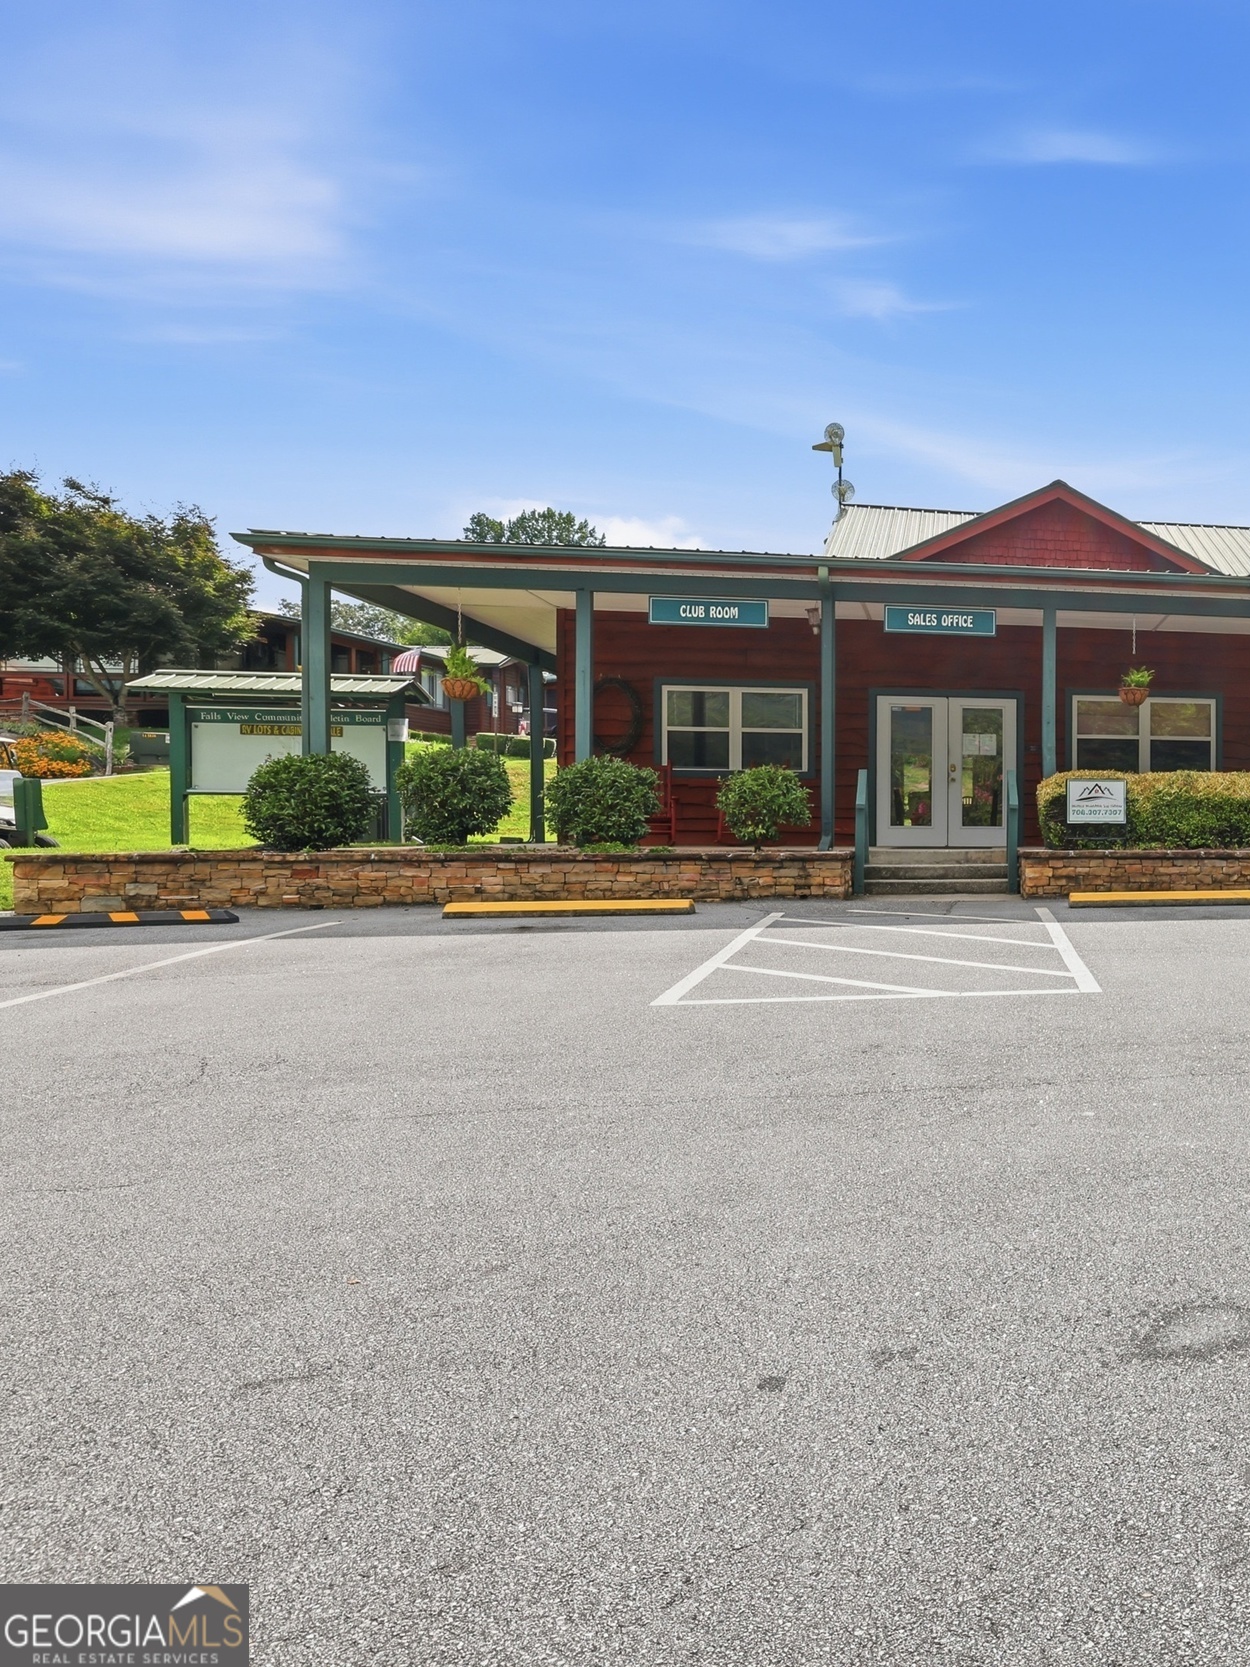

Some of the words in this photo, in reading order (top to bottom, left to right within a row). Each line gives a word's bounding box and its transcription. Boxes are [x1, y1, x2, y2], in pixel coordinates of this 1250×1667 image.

[680, 605, 705, 618] CLUB
[710, 606, 739, 619] ROOM
[908, 613, 937, 626] SALES
[941, 615, 973, 627] OFFICE
[201, 712, 221, 720] Falls
[255, 713, 302, 721] Communit
[355, 714, 381, 722] Board
[242, 725, 251, 734] RV
[253, 725, 271, 734] LOTS
[274, 726, 279, 734] &
[281, 727, 302, 735] CABIN
